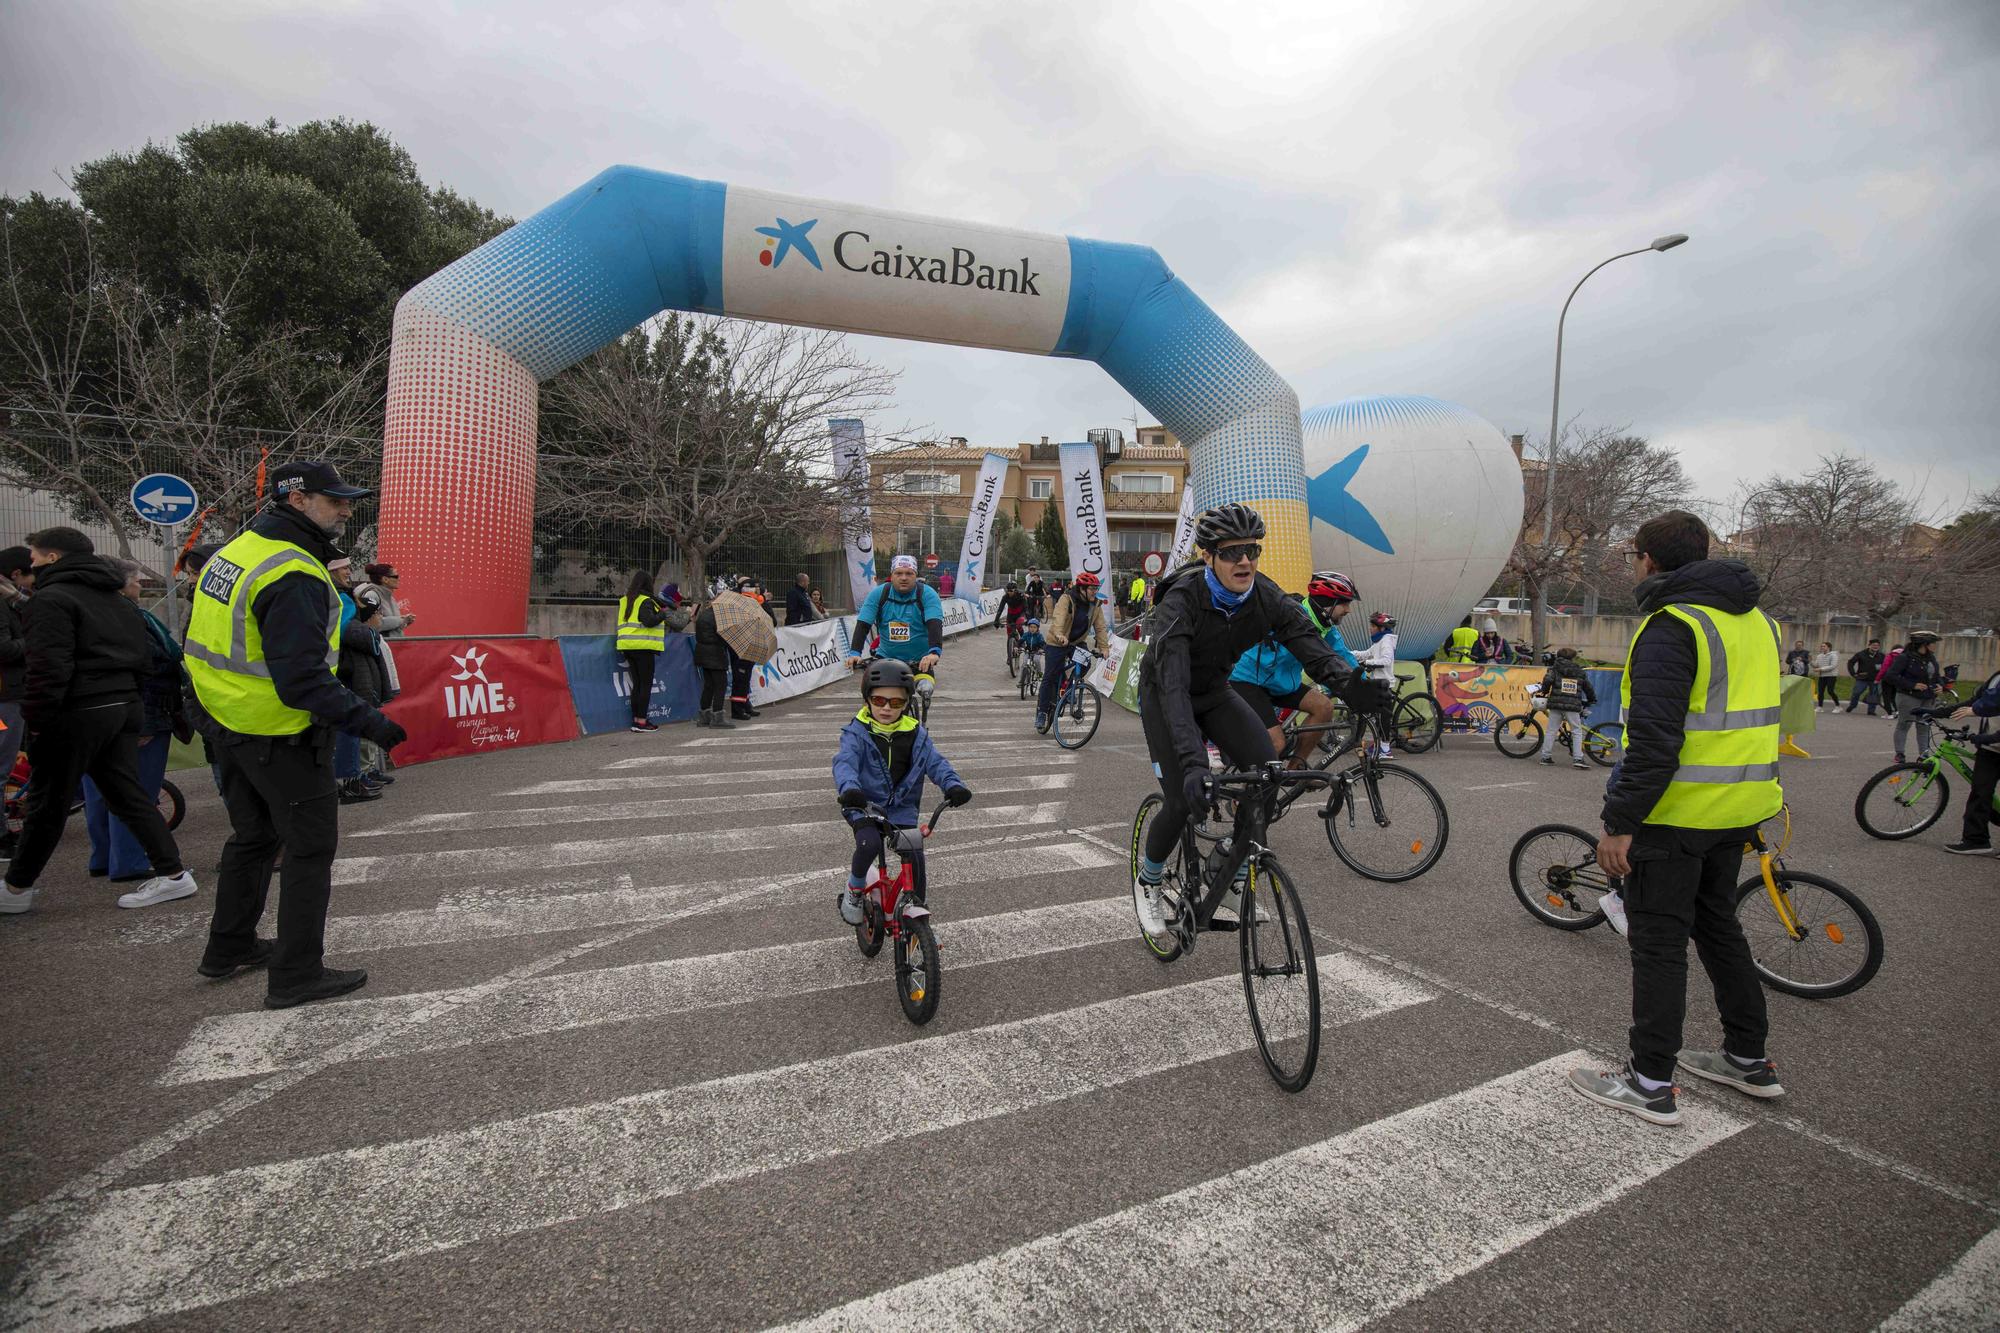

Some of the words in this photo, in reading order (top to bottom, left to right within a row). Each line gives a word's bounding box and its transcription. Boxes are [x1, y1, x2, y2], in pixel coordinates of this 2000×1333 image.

[833, 230, 1041, 297] CaixaBank
[277, 476, 304, 489] POLICIA
[286, 481, 306, 491] LOCAL
[968, 475, 998, 557] CaixaBank
[1074, 467, 1104, 575] CaixaBank
[209, 556, 241, 584] POLICIA
[204, 574, 232, 601] LOCAL
[890, 627, 909, 636] 0222
[776, 638, 840, 679] CaixaBank
[444, 682, 506, 718] IME
